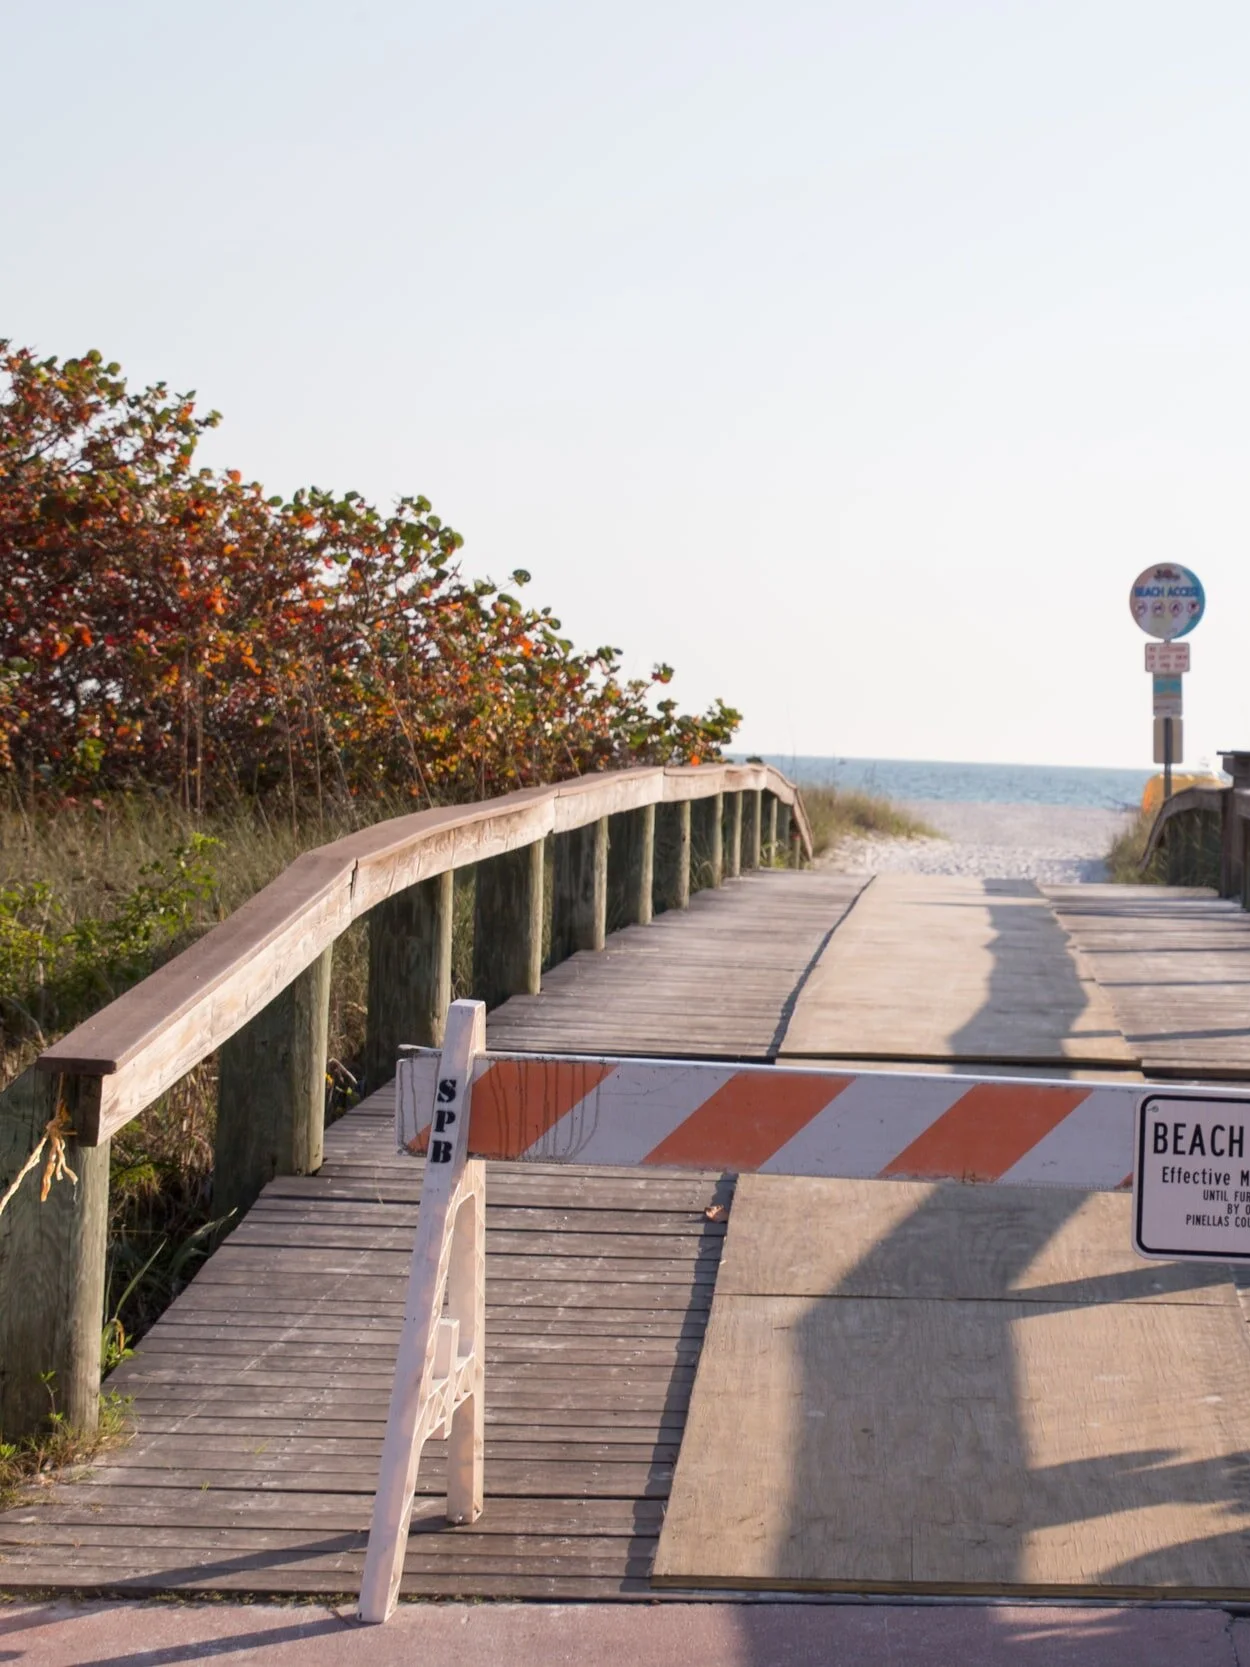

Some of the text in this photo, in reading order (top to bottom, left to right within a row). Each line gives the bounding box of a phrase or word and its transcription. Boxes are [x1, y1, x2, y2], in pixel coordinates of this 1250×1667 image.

[1135, 586, 1164, 597] BEACH
[1153, 1122, 1245, 1158] BEACH
[1162, 1166, 1231, 1186] Effective
[1203, 1190, 1229, 1202] UNTIL
[1227, 1204, 1239, 1215] BY
[1186, 1214, 1229, 1227] PINELLAS
